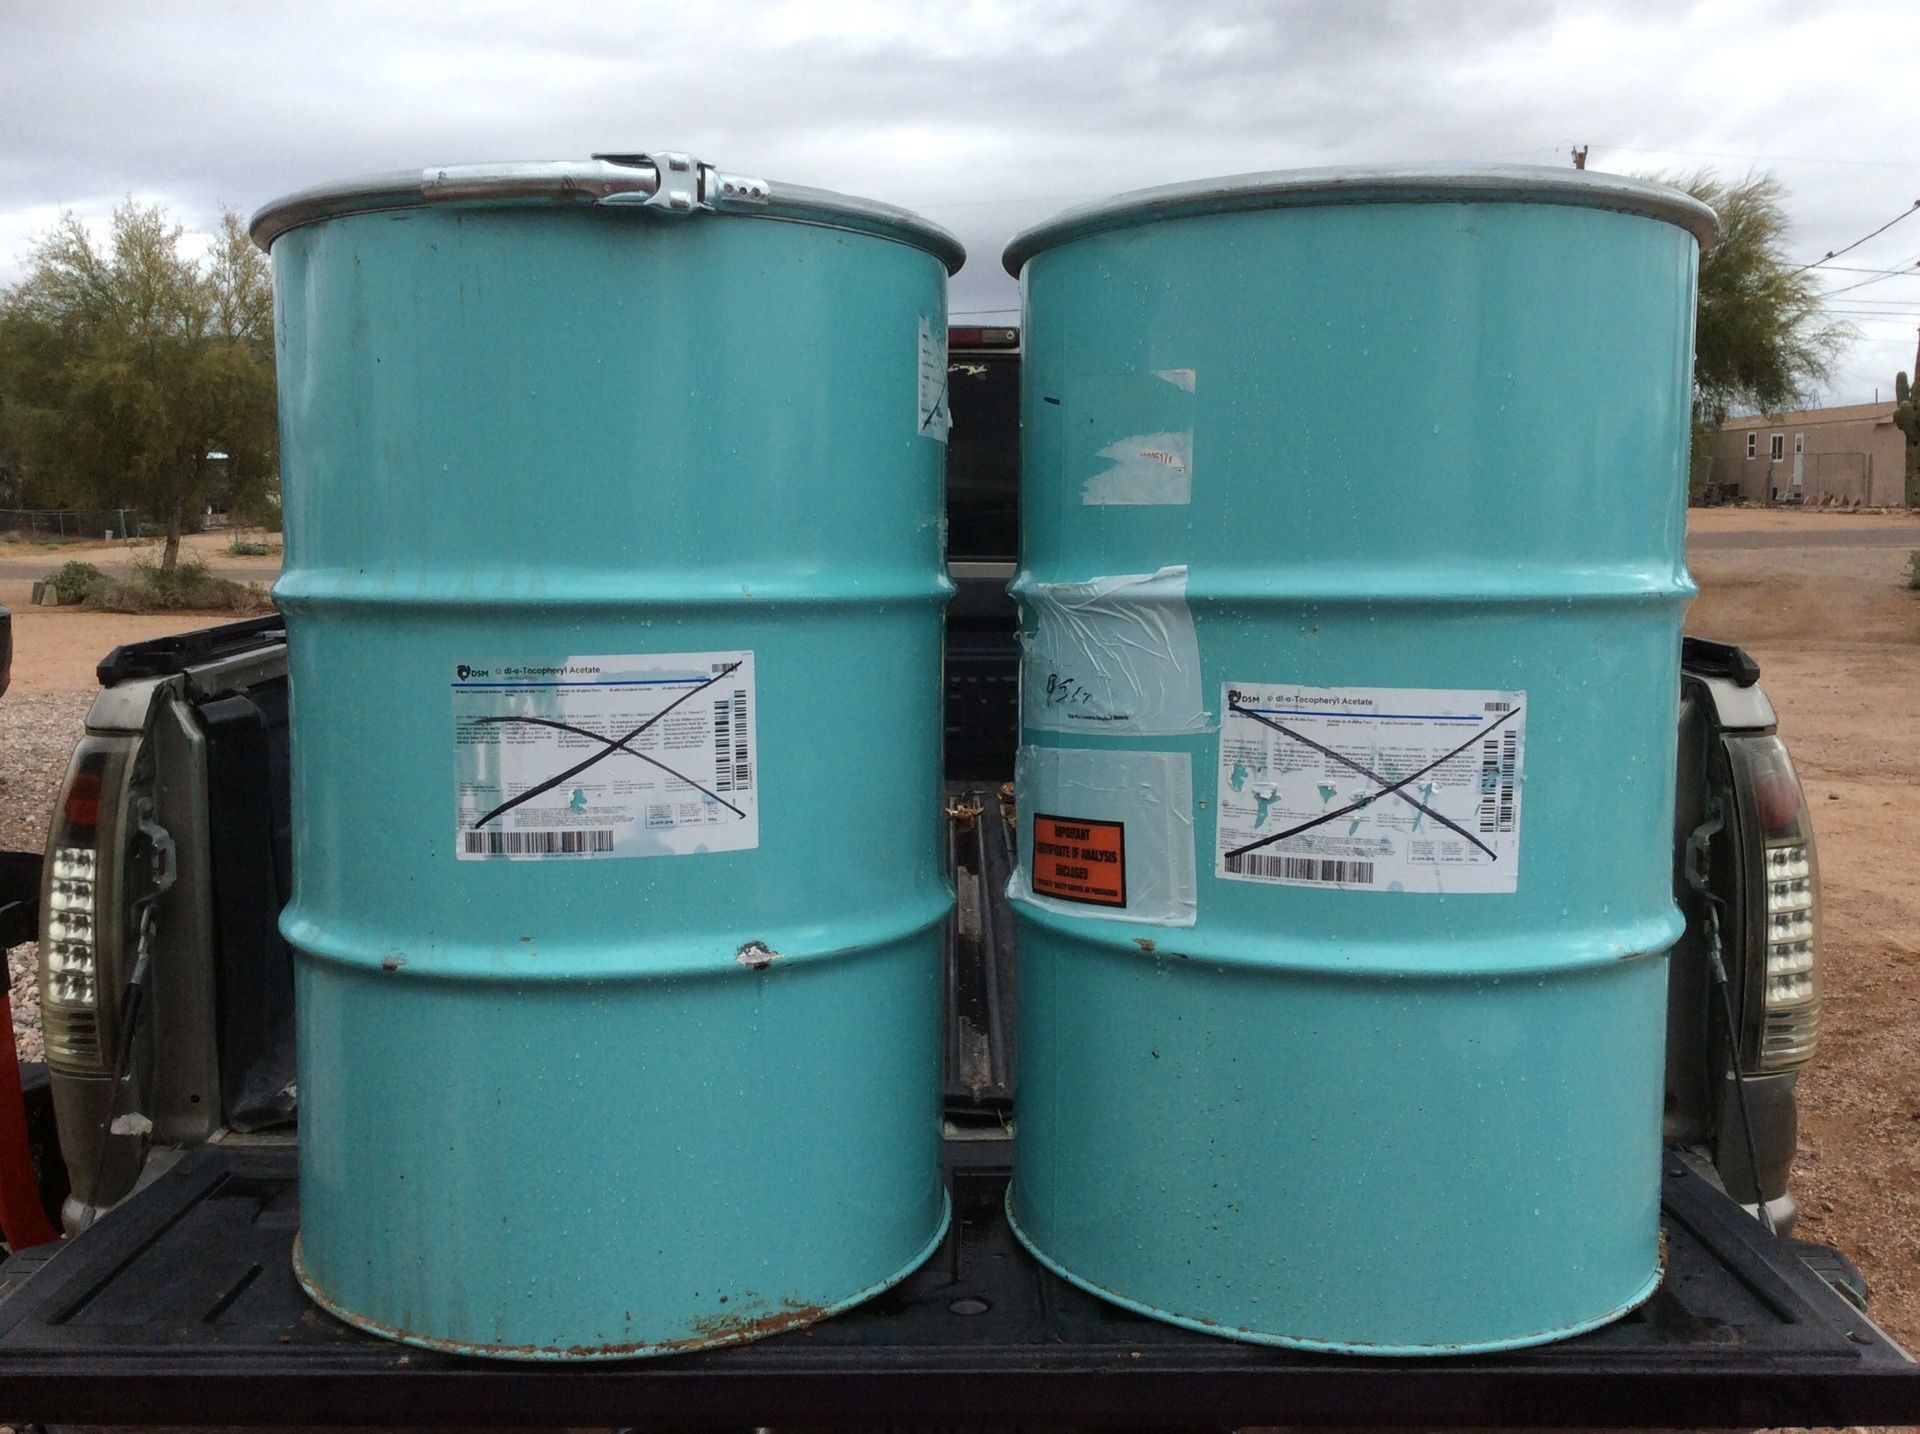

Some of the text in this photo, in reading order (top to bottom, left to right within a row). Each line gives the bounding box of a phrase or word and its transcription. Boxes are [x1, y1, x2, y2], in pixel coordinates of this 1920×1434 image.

[471, 669, 489, 678] DSM
[569, 665, 601, 675] Acetate
[1241, 695, 1260, 704] DSM
[1341, 697, 1374, 706] Acetate
[1081, 848, 1118, 864] ANALYSIS
